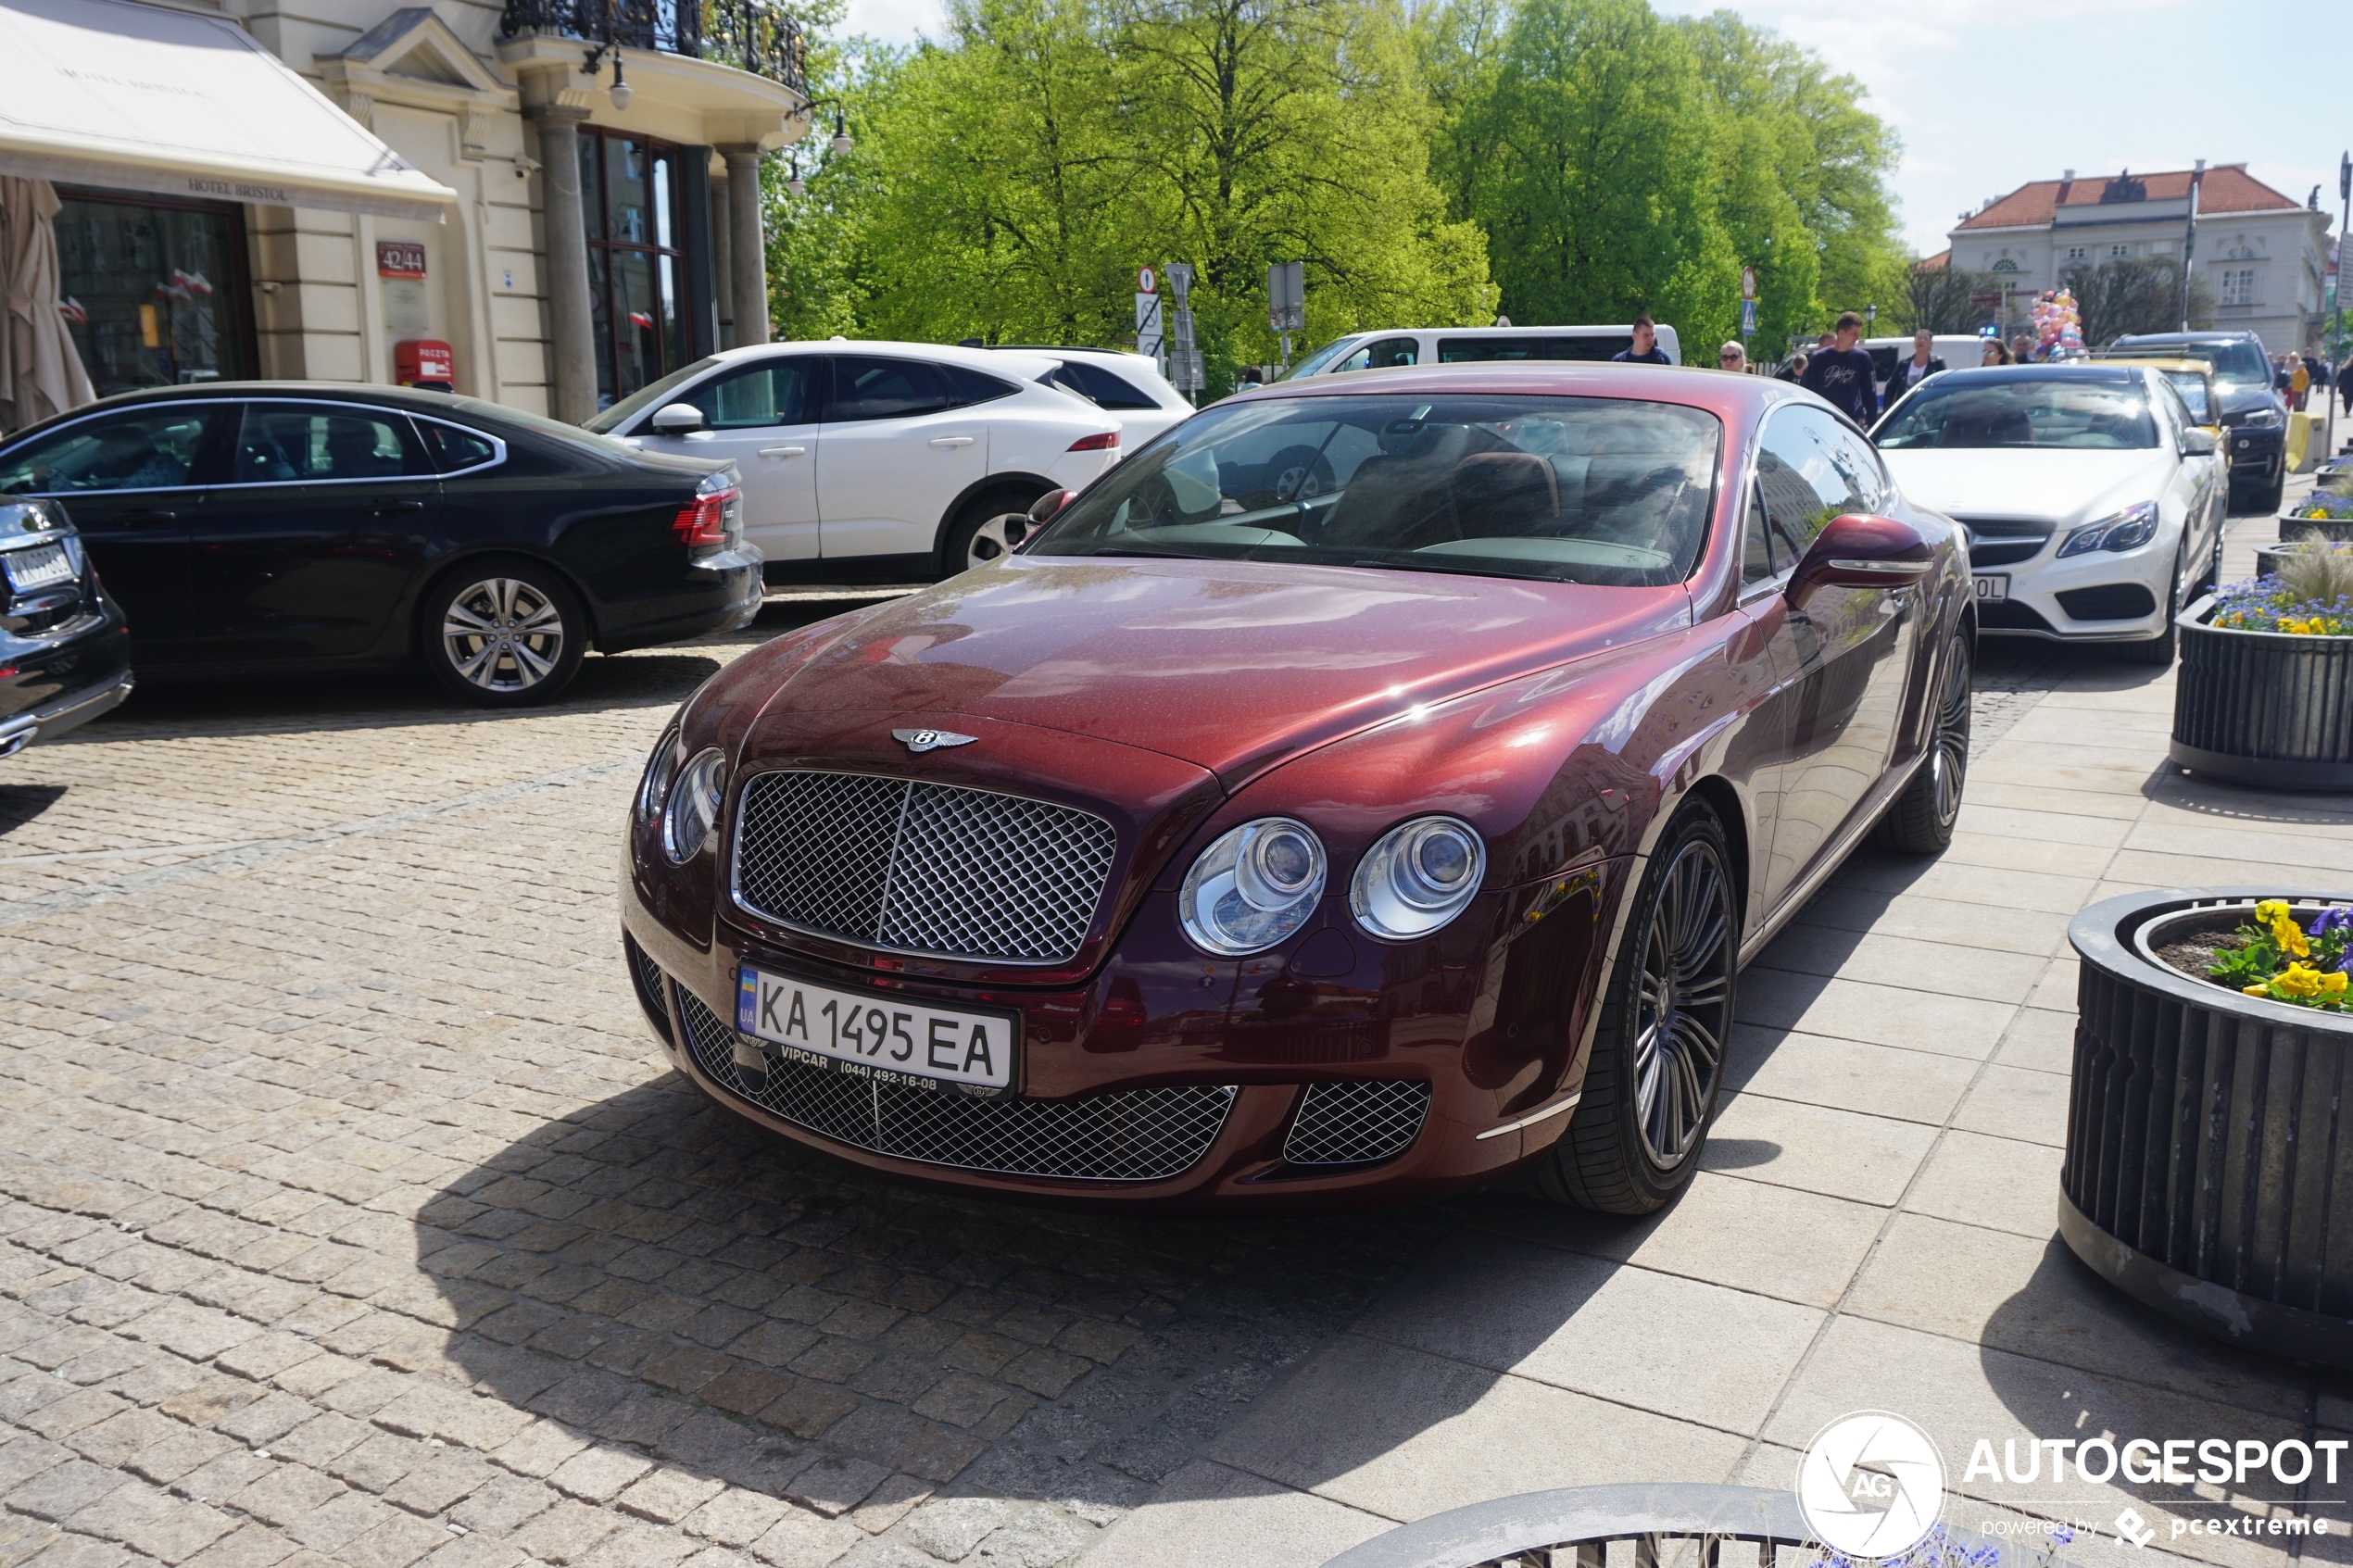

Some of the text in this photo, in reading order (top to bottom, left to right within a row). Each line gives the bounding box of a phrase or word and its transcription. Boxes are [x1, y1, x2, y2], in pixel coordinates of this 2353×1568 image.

[188, 178, 288, 201] HOTEL BRISTOL
[383, 249, 423, 270] 42/44
[420, 348, 450, 358] POCZTA
[740, 982, 994, 1076] UA KA 1495 EA
[781, 1045, 937, 1091] VIPCAR (044) 492-16-08
